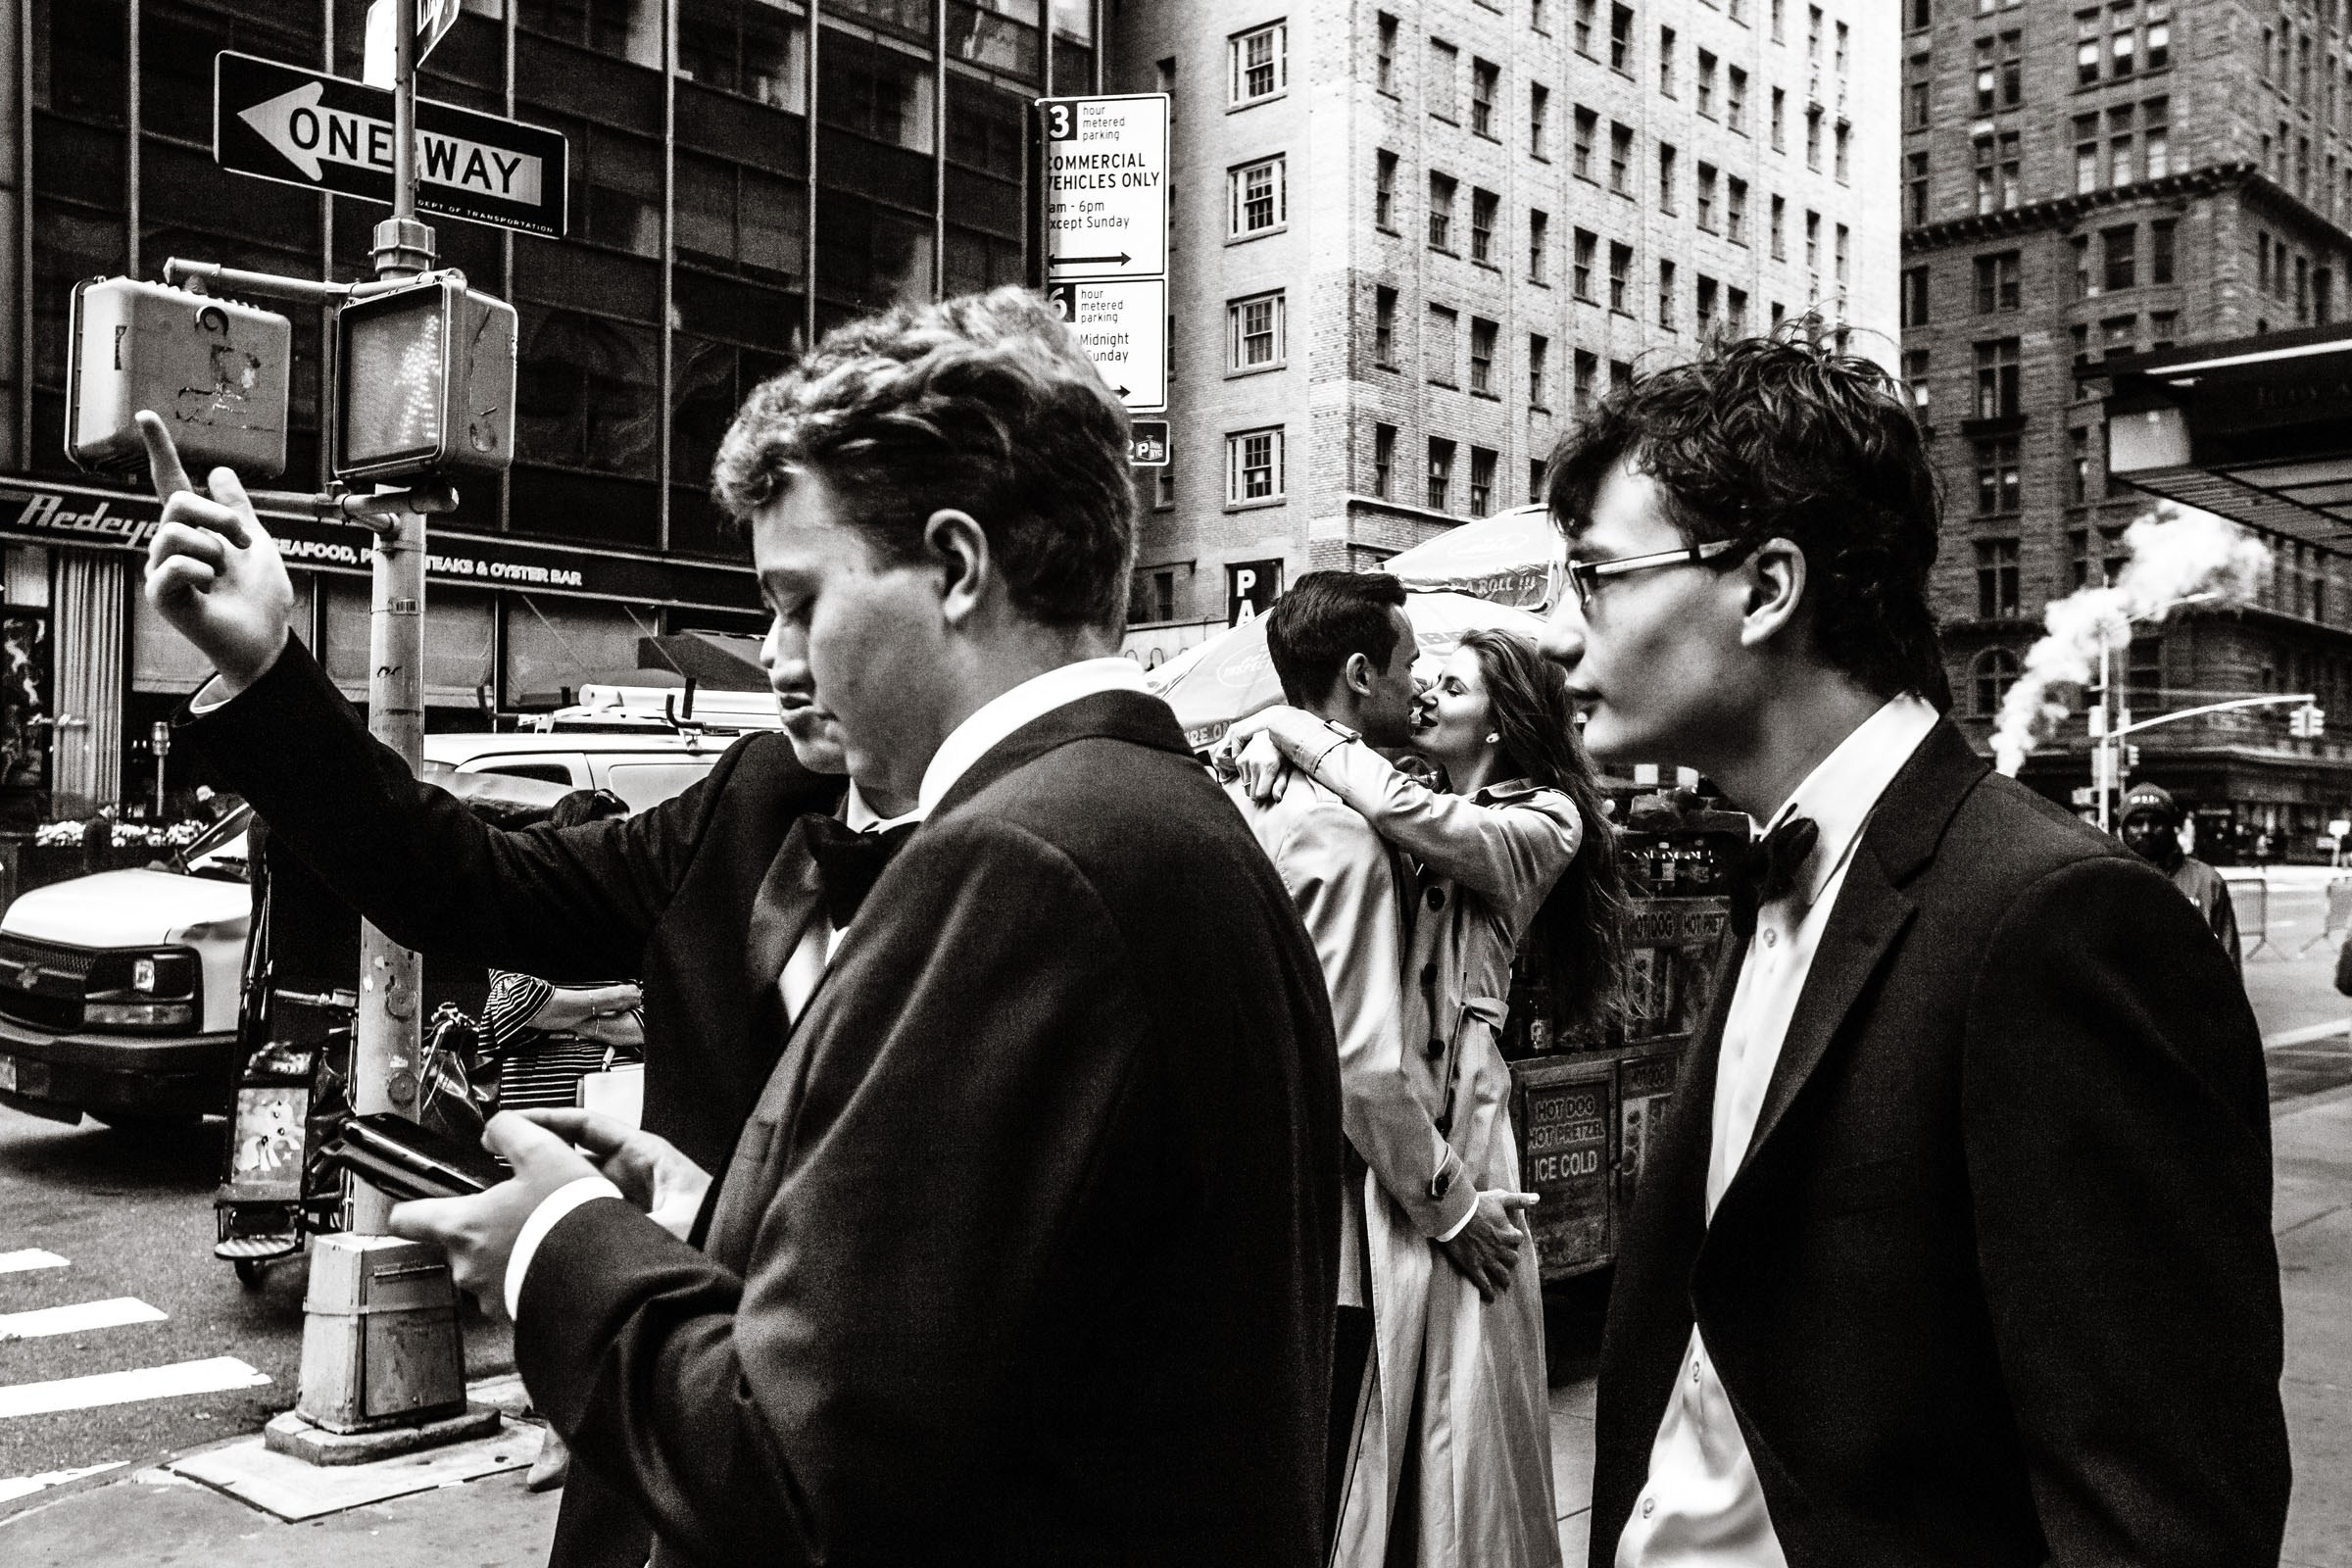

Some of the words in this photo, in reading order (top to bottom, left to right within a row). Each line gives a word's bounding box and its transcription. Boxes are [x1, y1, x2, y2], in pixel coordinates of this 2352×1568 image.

[1083, 106, 1105, 116] hour
[1050, 105, 1070, 138] 3
[1083, 117, 1125, 128] metered
[1083, 129, 1120, 142] parking
[289, 107, 393, 167] ONE
[423, 136, 522, 194] WAY
[1122, 172, 1160, 188] ONLY
[1050, 203, 1067, 214] am
[1079, 200, 1104, 214] 6pm
[417, 199, 443, 210] DEPT
[466, 209, 553, 233] TRANSPORTATION
[1050, 218, 1083, 230] xcept
[1087, 216, 1130, 230] Sunday
[1081, 289, 1103, 299] hour
[1049, 287, 1068, 319] 6
[1081, 300, 1124, 311] metered
[1081, 313, 1118, 323] parking
[1080, 333, 1130, 347] Midnight
[1138, 443, 1150, 457] P
[425, 555, 474, 574] TEAKS
[476, 561, 489, 576] &
[490, 563, 549, 582] OYSTER
[550, 569, 582, 586] BAR
[1479, 577, 1513, 594] ROLL
[1537, 1102, 1564, 1120] HOT
[1567, 1097, 1594, 1116] DOG
[1556, 1118, 1605, 1145] PRETZEL
[1535, 1156, 1557, 1182] ICE
[1560, 1151, 1598, 1177] COLD
